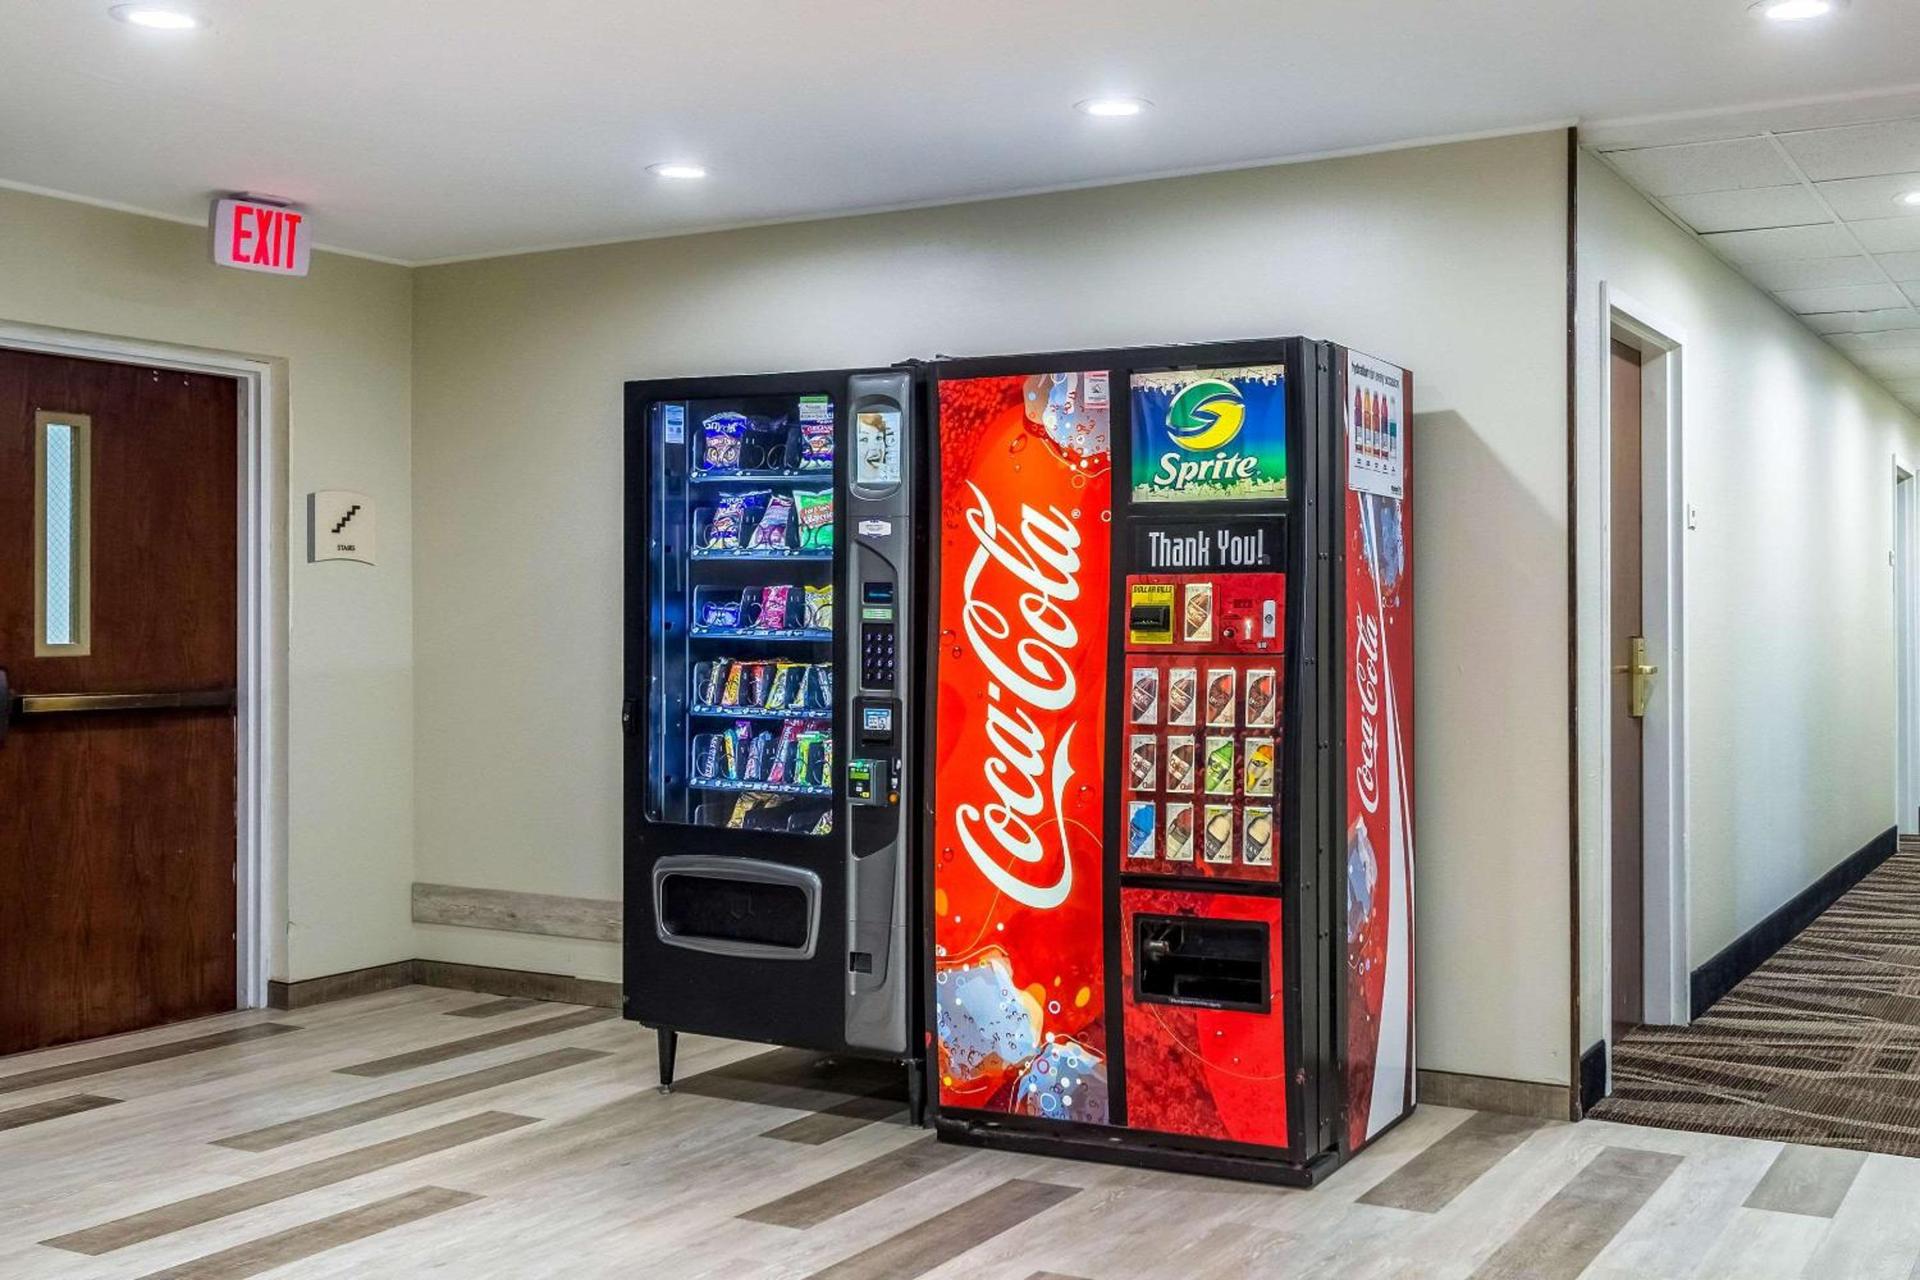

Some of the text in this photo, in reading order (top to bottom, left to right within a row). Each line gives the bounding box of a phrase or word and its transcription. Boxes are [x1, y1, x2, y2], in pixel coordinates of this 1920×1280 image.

[232, 204, 302, 269] EXIT
[1153, 451, 1259, 490] Sprite
[1148, 529, 1264, 567] Thank You!
[1133, 585, 1172, 593] DOLLAR BILLS
[956, 479, 1082, 909] Coca-Cola
[1356, 601, 1379, 814] Coca-Cola
